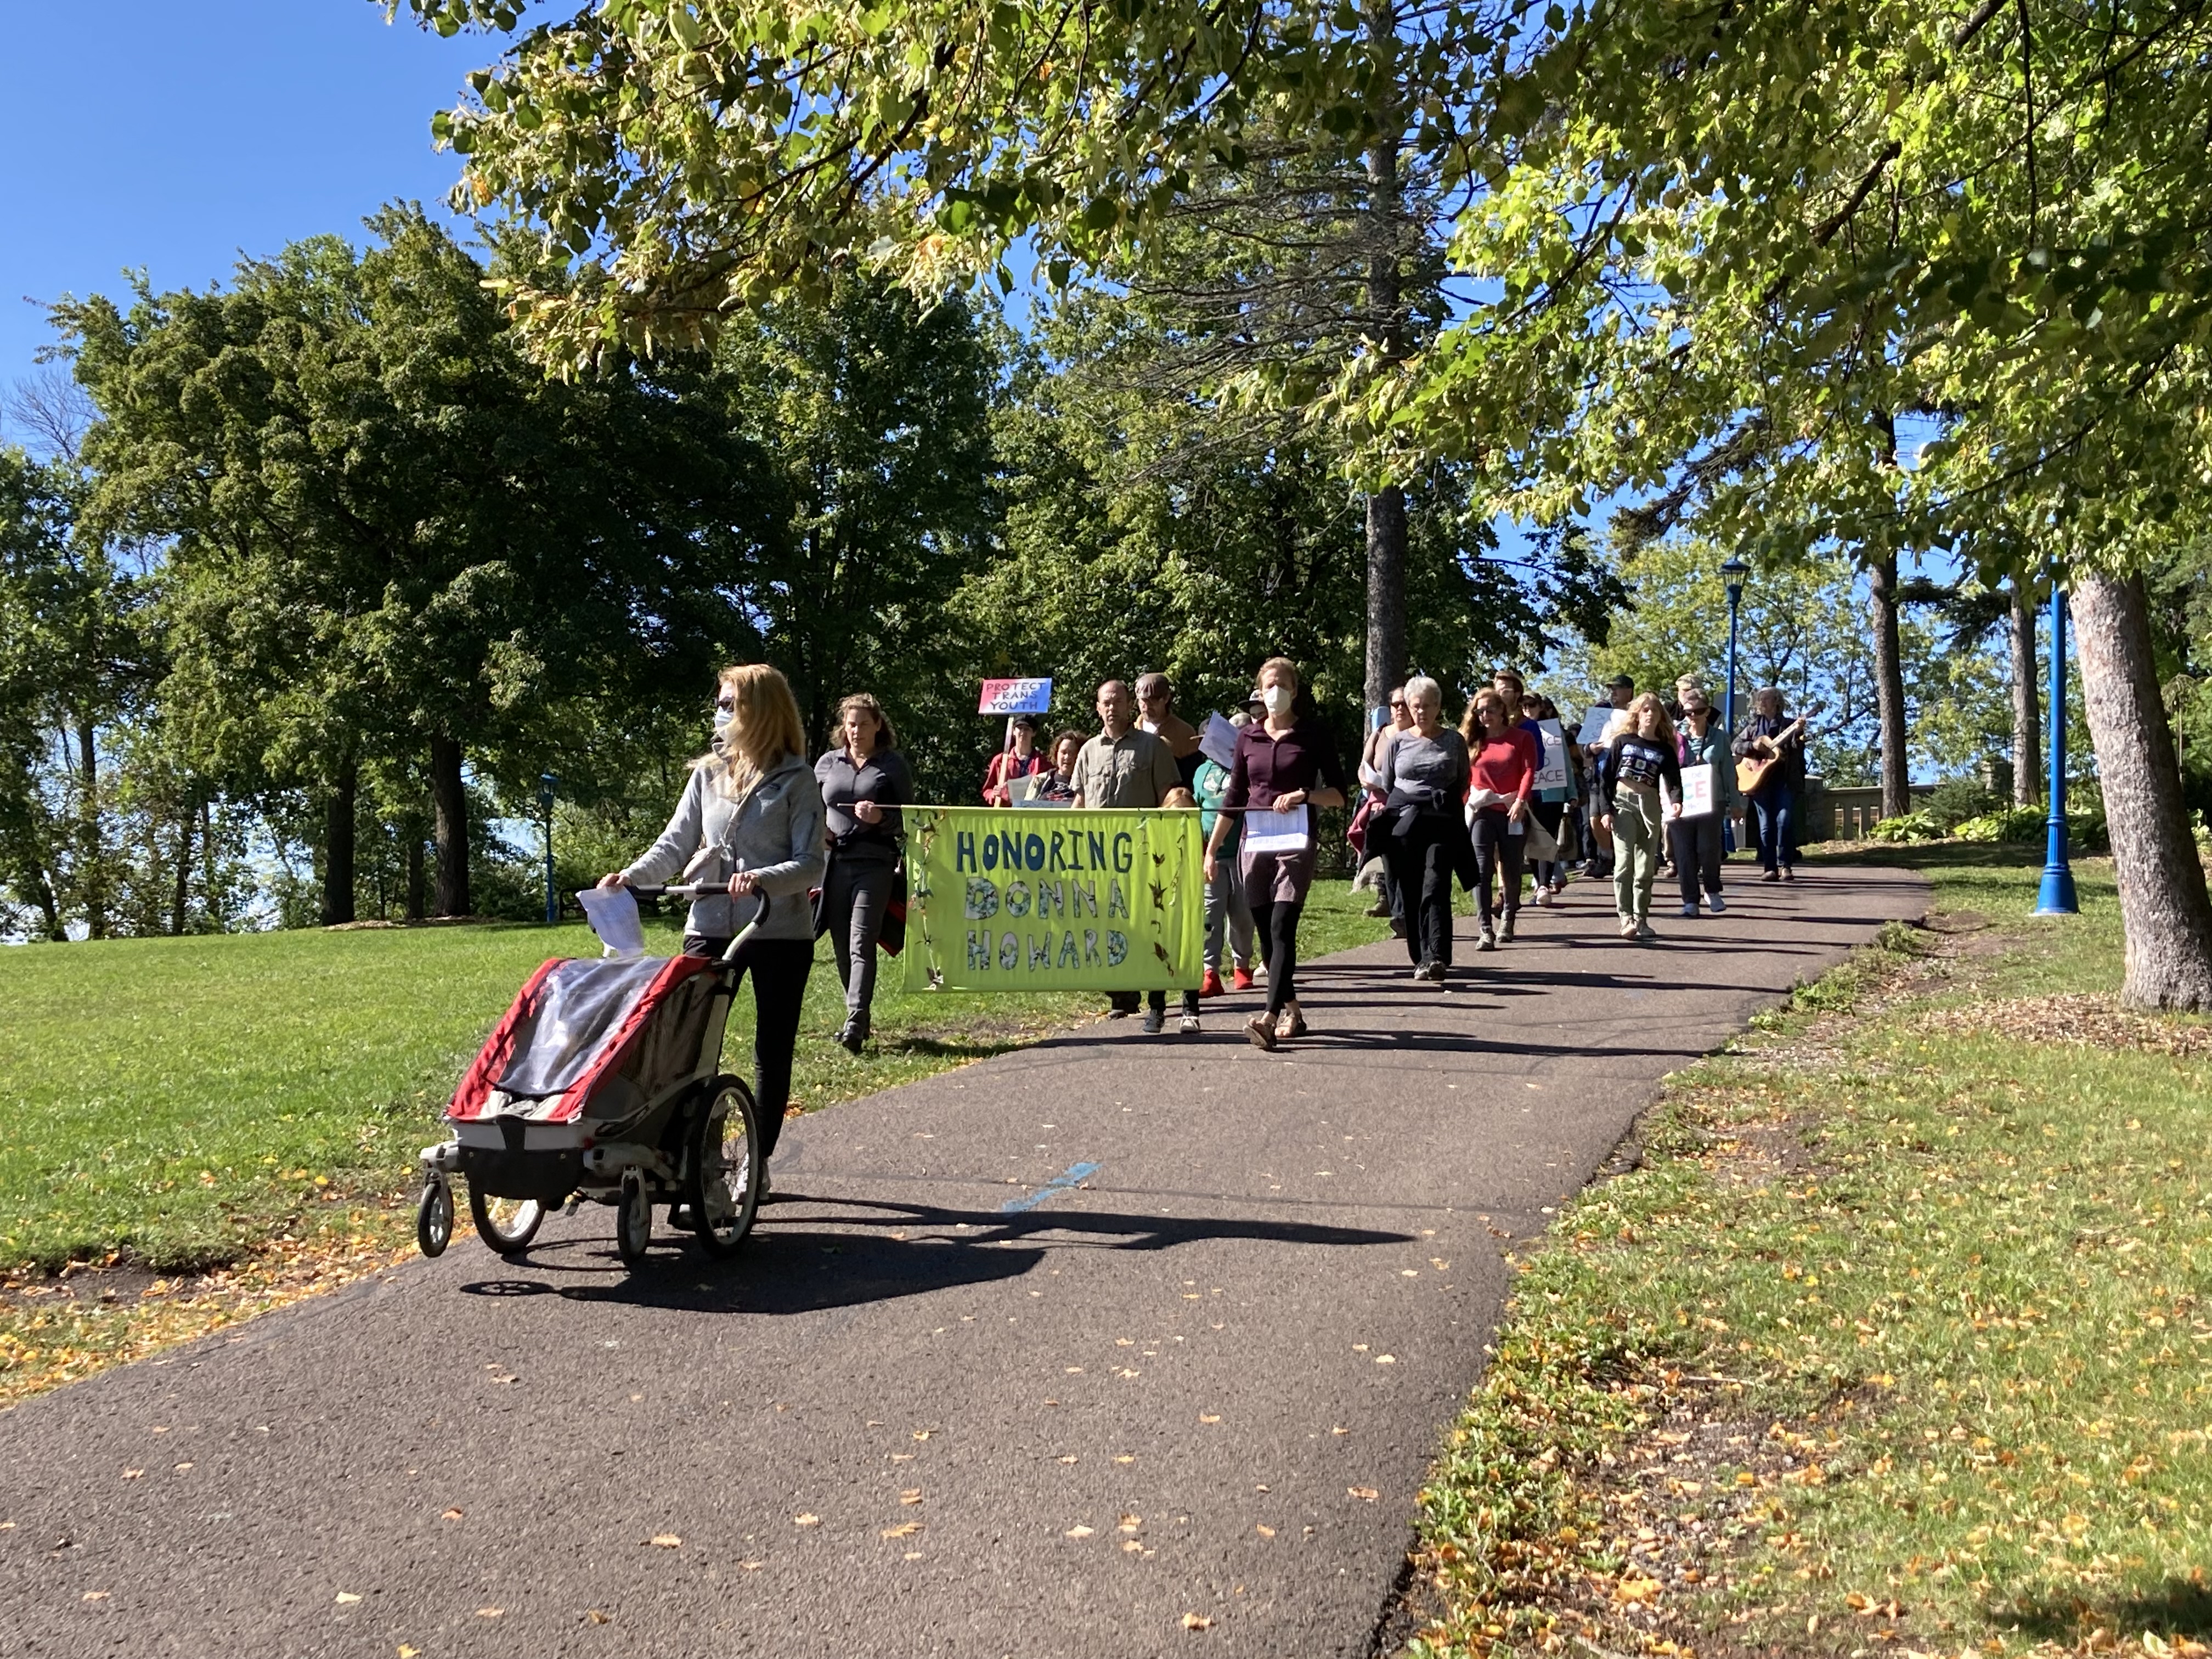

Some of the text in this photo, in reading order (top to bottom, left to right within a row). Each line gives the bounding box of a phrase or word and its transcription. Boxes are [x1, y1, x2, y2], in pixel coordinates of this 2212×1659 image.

[986, 682, 1046, 692] PROTECT
[992, 691, 1038, 699] TRANS
[990, 702, 1037, 710] YOUTH
[1534, 769, 1564, 784] EACE
[956, 830, 1133, 873] HONORING
[964, 877, 1129, 921] DONNA
[967, 928, 1128, 972] HOWARD
